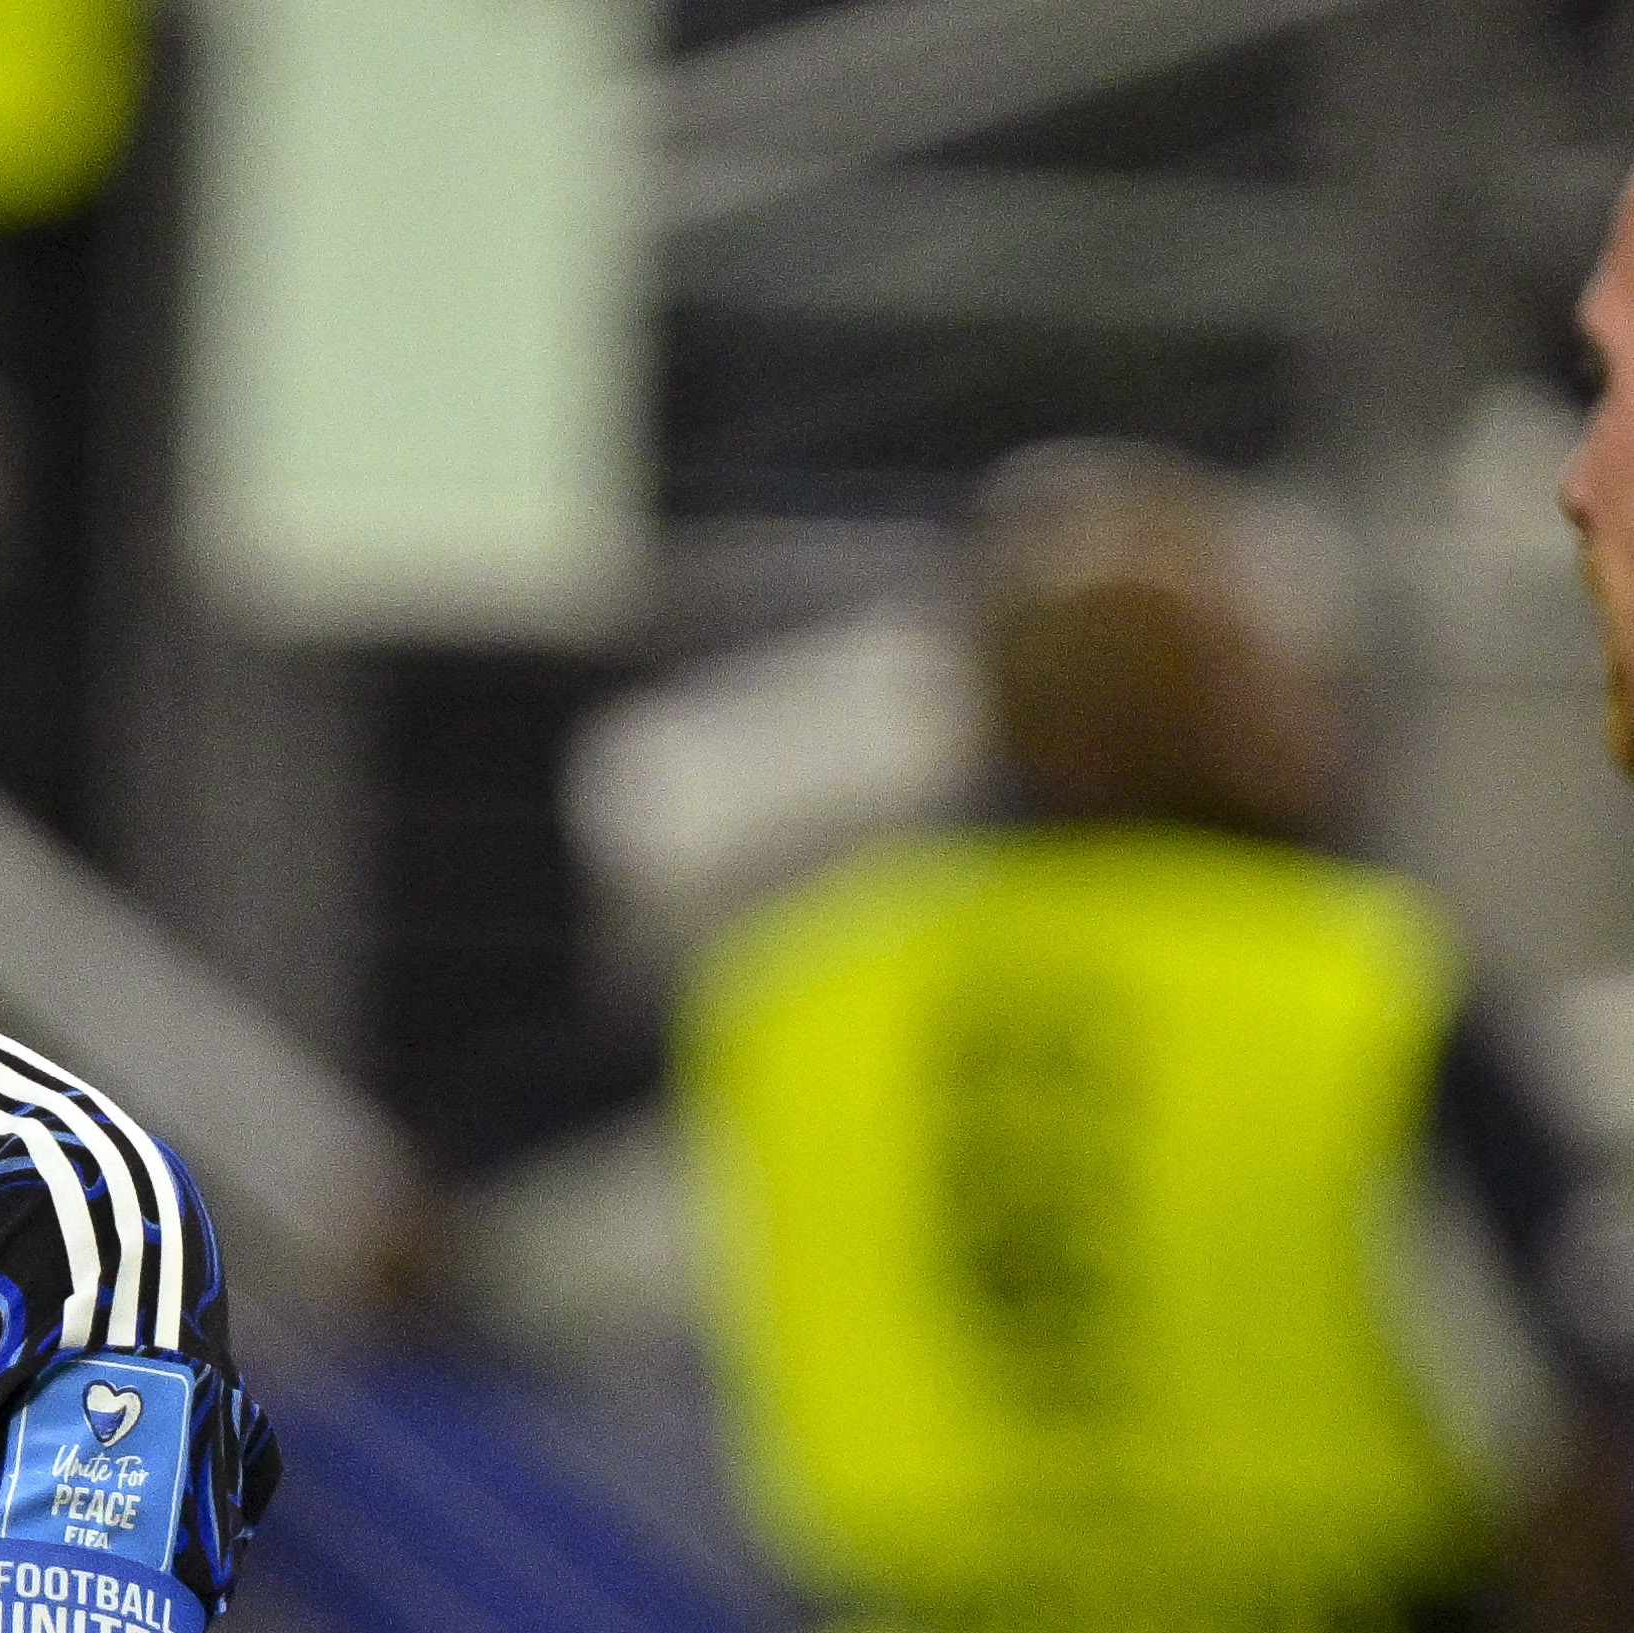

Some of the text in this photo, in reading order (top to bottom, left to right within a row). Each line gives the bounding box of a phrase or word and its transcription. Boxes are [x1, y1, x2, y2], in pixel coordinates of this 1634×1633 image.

[52, 1443, 149, 1489] Unite For
[51, 1483, 142, 1530] PEACE
[64, 1525, 110, 1549] FIFA
